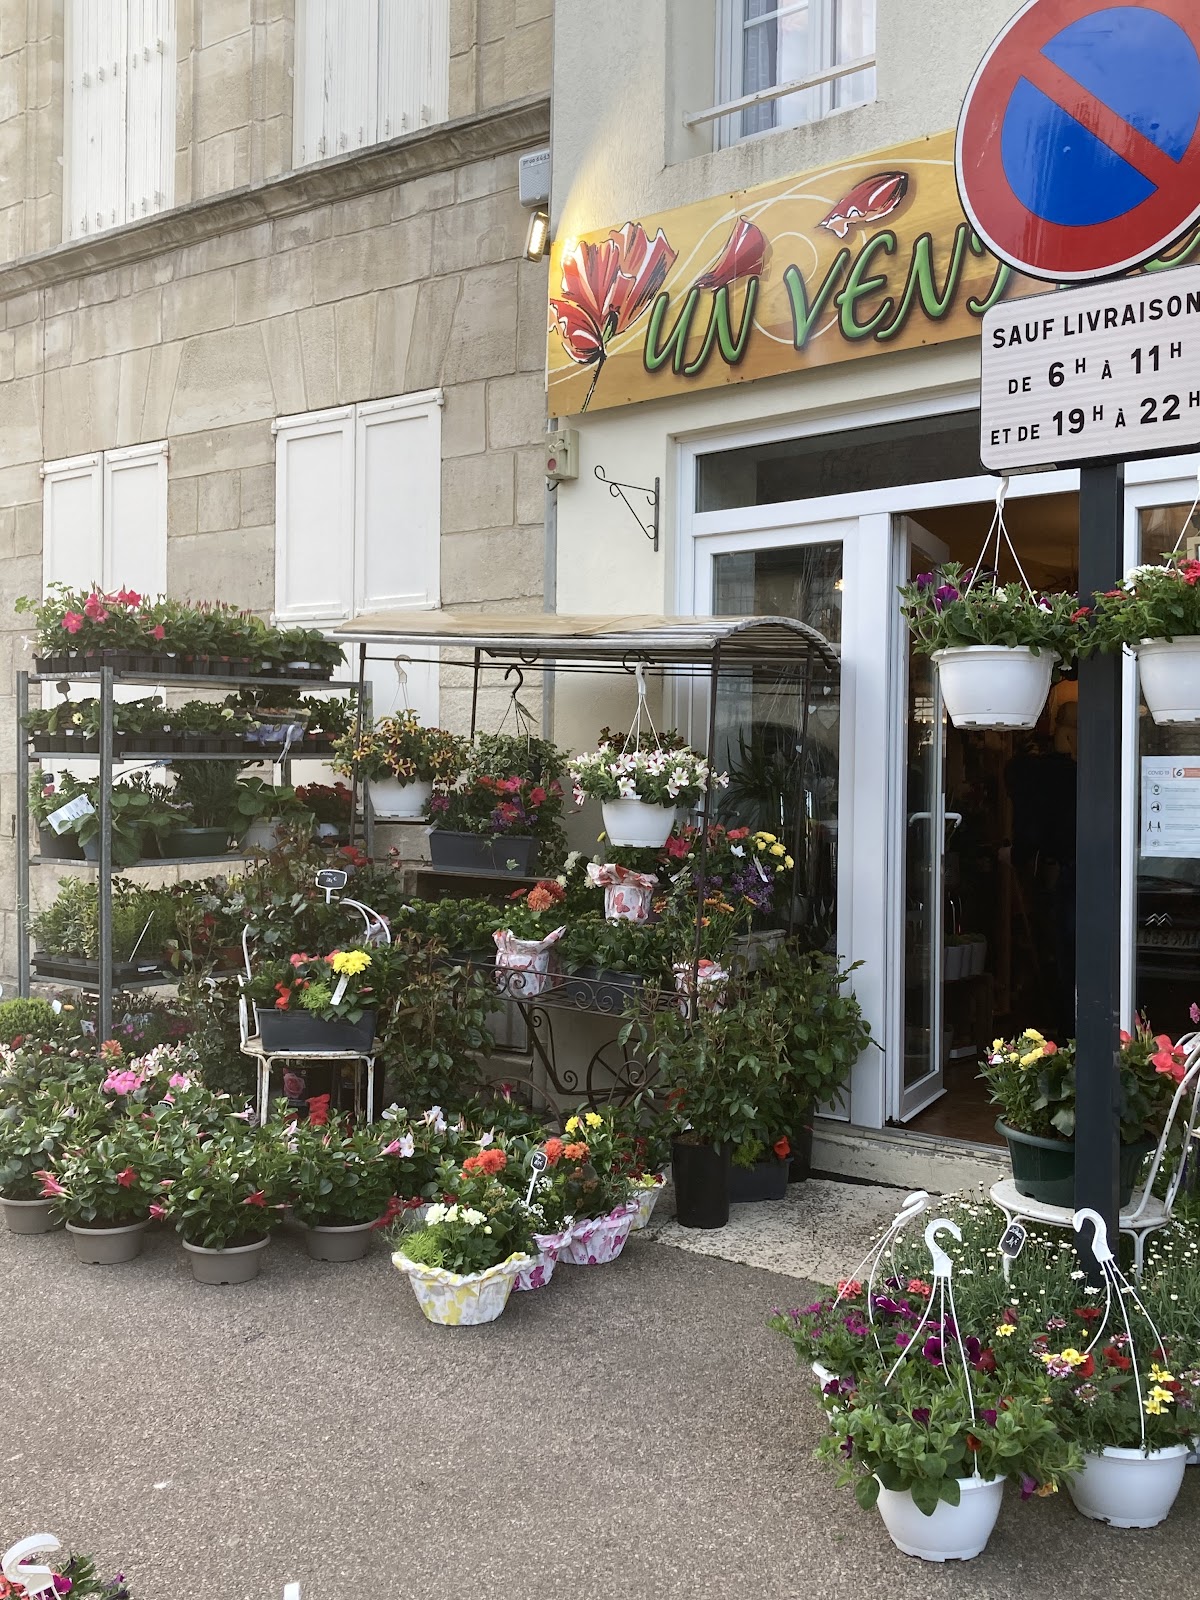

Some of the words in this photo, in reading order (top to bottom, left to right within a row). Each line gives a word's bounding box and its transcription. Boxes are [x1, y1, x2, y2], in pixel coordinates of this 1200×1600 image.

[643, 275, 759, 377] UN
[992, 318, 1055, 349] SAUF
[1063, 290, 1200, 337] LIVRAISON
[1008, 376, 1032, 395] DE
[1101, 359, 1112, 380] À
[991, 428, 1012, 446] ET
[1018, 423, 1040, 442] DE
[1115, 408, 1126, 429] À
